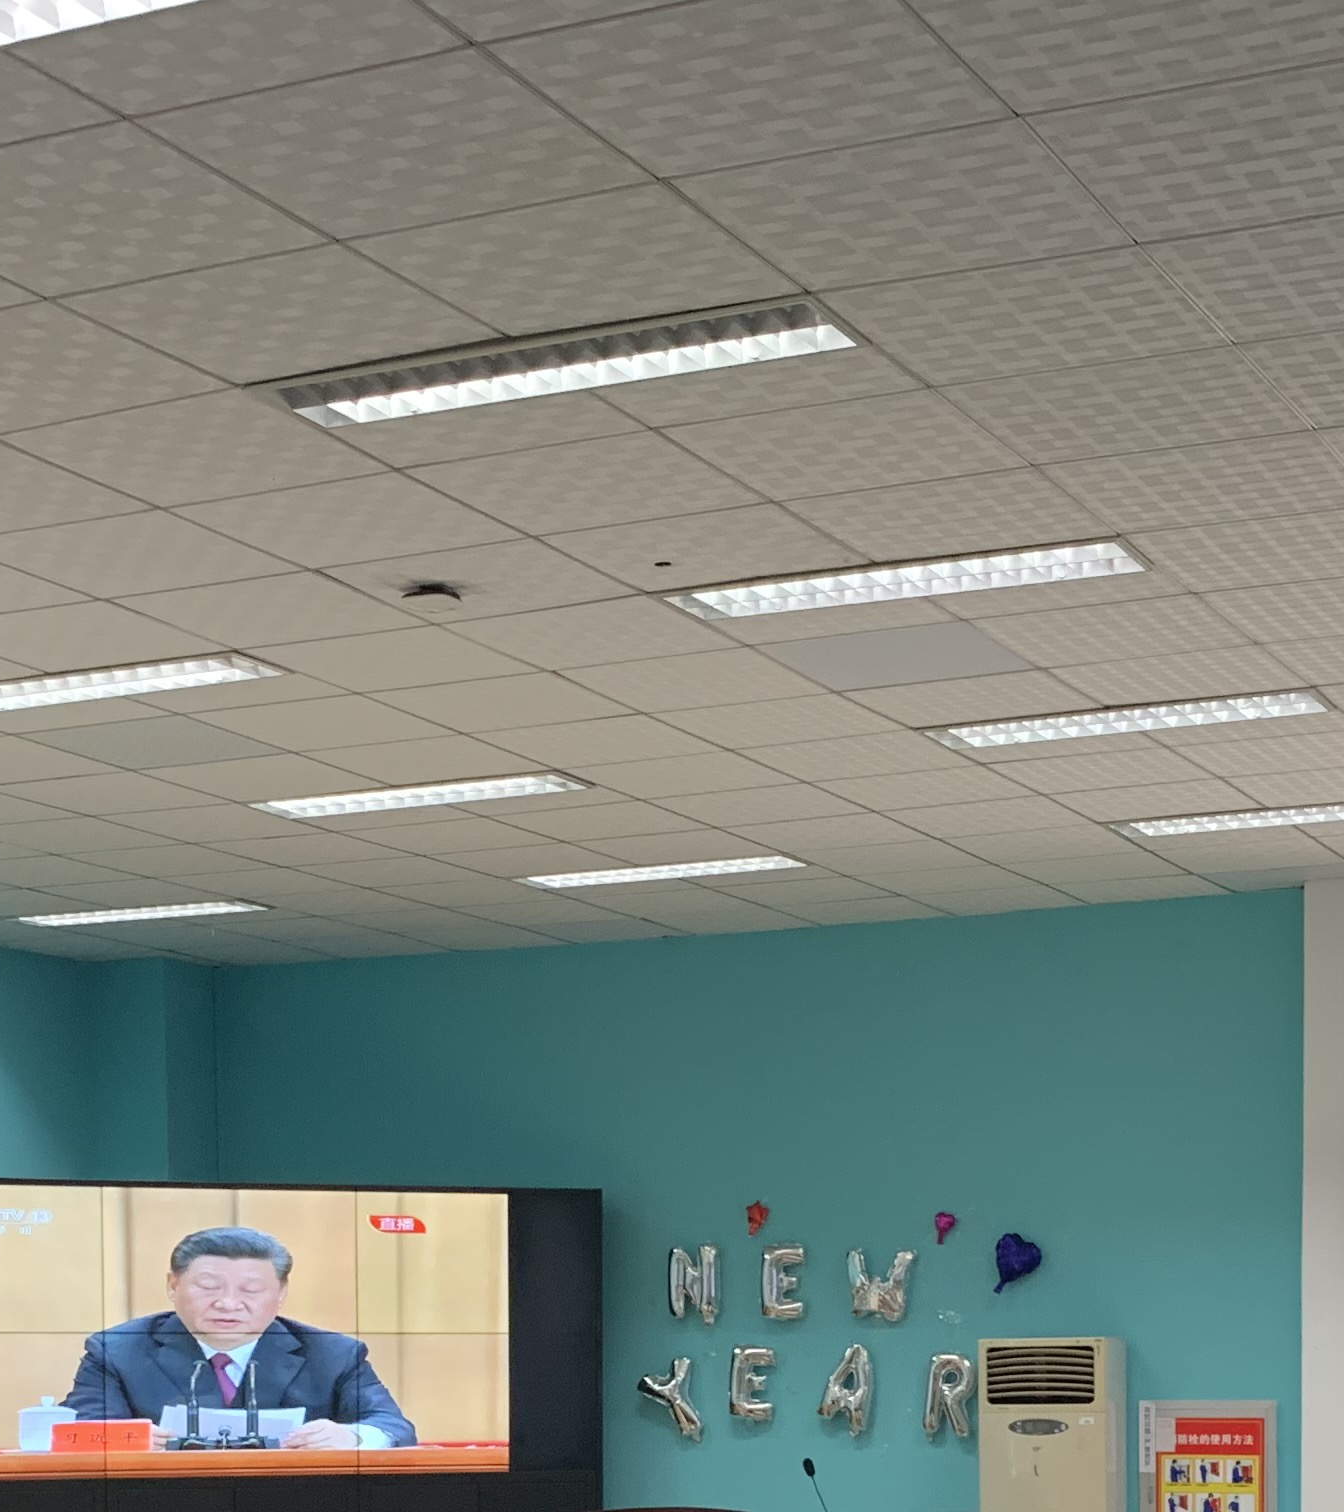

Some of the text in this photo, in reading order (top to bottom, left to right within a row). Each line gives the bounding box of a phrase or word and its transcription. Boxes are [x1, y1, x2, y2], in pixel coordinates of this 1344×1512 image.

[31, 1209, 50, 1223] 13
[378, 1217, 415, 1232] 直播
[667, 1241, 917, 1325] NEW
[637, 1343, 978, 1443] YEAR
[1175, 1433, 1254, 1446] 防栓的使用方法
